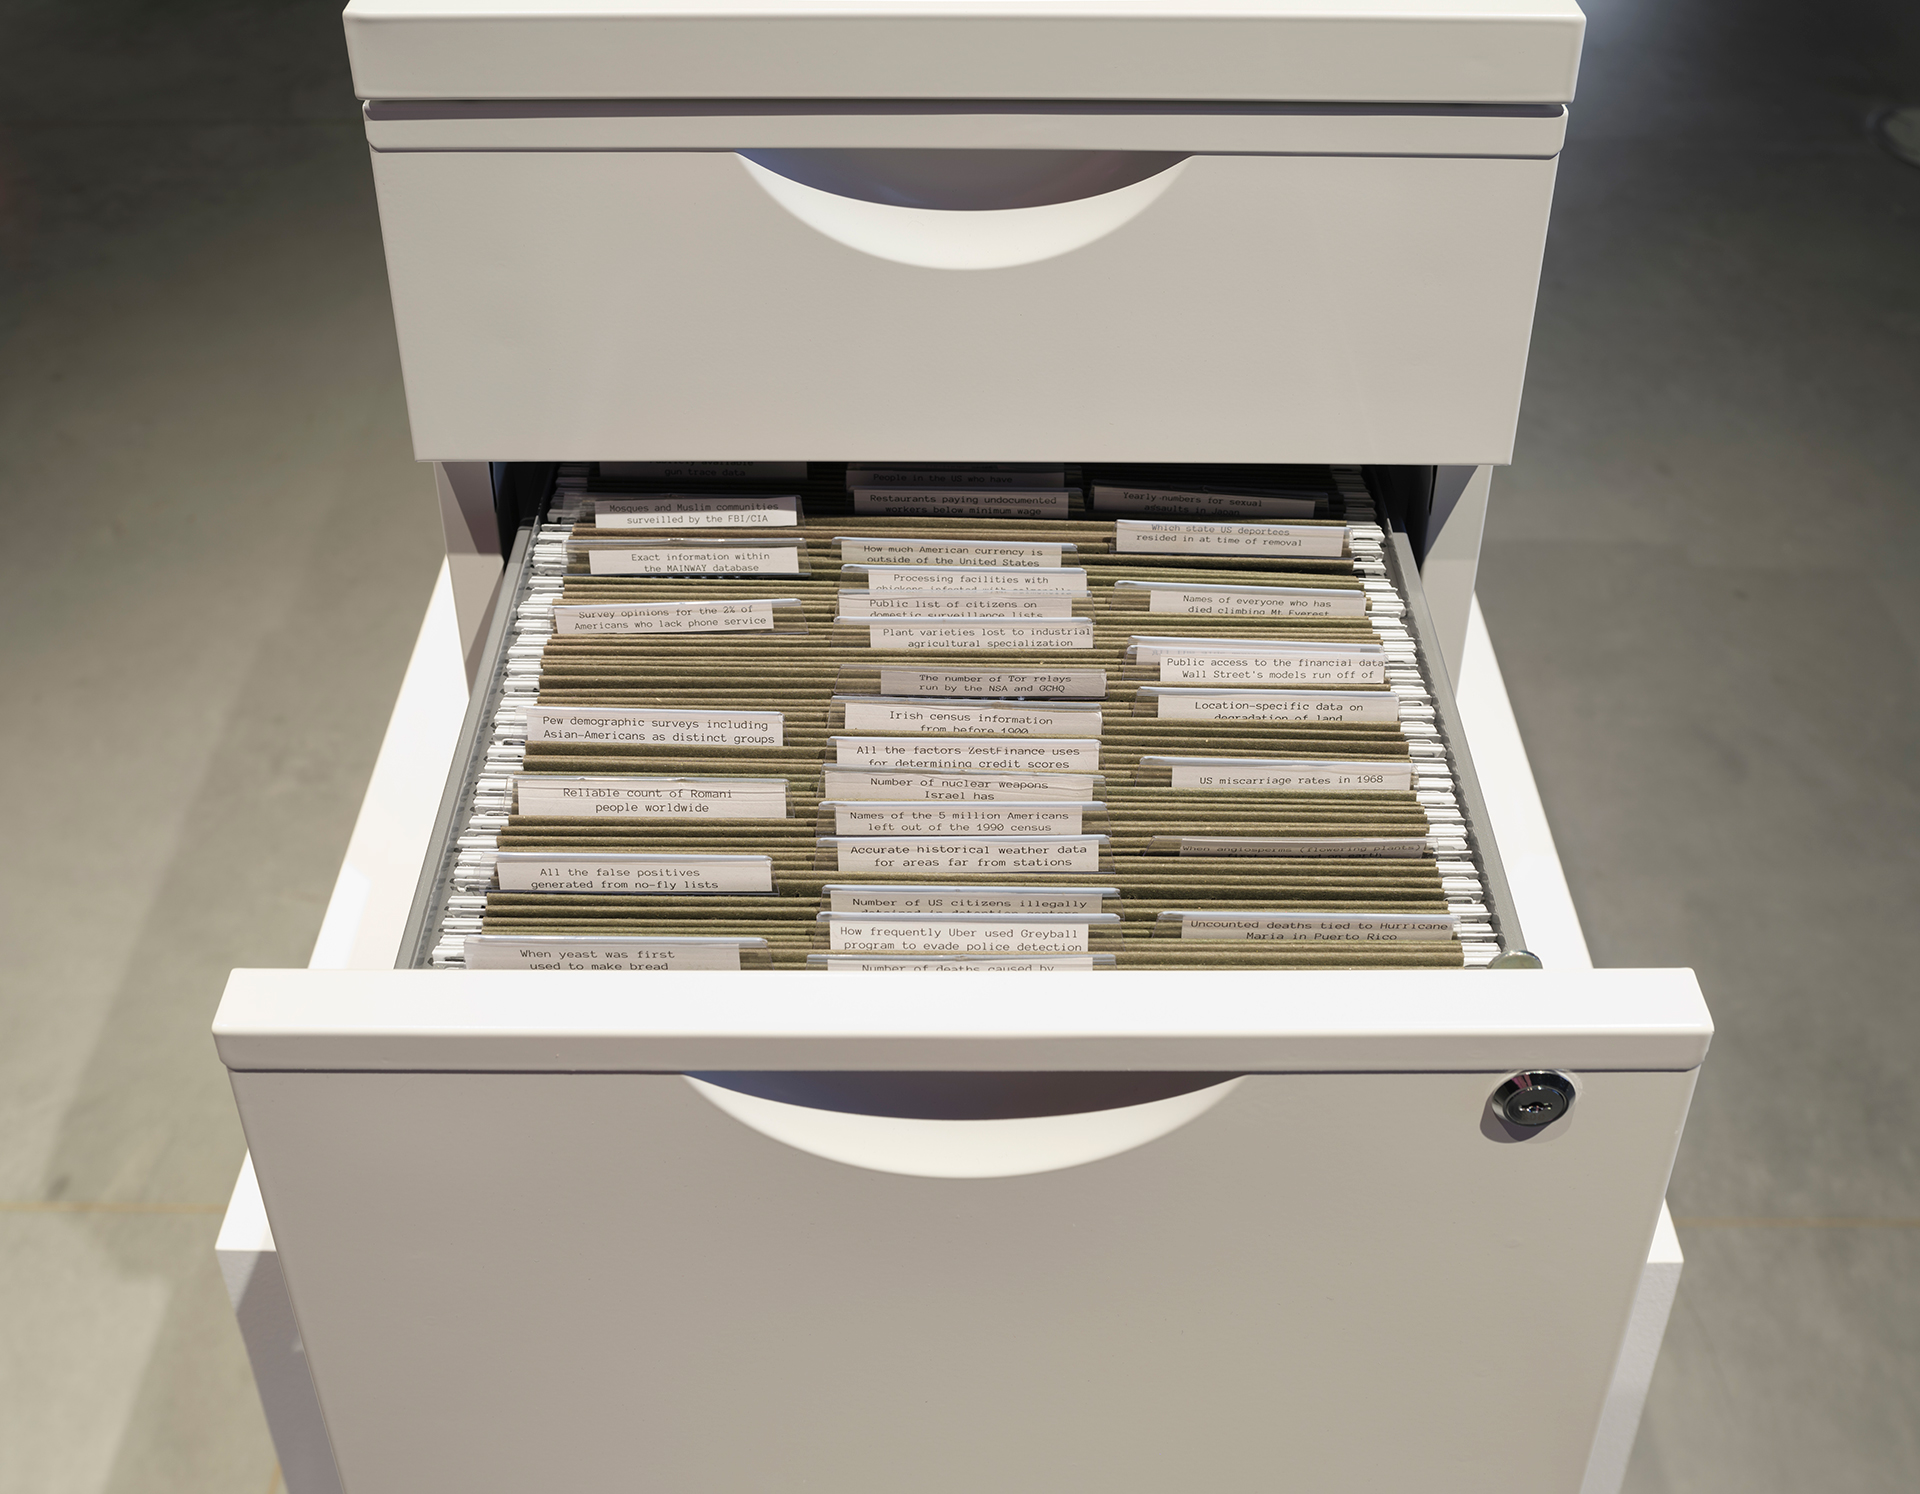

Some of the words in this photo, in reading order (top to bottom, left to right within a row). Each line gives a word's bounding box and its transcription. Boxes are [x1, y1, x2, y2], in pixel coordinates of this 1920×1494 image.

[869, 495, 936, 503] Restaurants
[941, 496, 978, 505] paying
[983, 496, 1056, 504] undocumented
[609, 504, 649, 514] Mosques
[654, 504, 671, 512] and
[676, 503, 711, 511] Muslim
[715, 503, 778, 511] communities
[933, 506, 964, 514] below
[1017, 508, 1042, 516] wage
[626, 515, 683, 524] surveilled
[688, 515, 700, 525] by
[705, 515, 722, 523] the
[727, 514, 768, 525] FBI/CIA
[631, 553, 660, 561] Exact
[666, 553, 729, 561] information
[734, 552, 769, 560] within
[644, 564, 661, 572] the
[666, 564, 706, 572] MAINWAY
[712, 564, 759, 572] database
[893, 574, 953, 585] Processing
[960, 575, 1019, 584] facilities
[1024, 576, 1048, 584] with
[1182, 595, 1212, 603] Names
[1218, 596, 1230, 604] of
[1236, 598, 1284, 608] everyone
[1289, 598, 1308, 607] who
[1313, 599, 1331, 607] has
[574, 621, 628, 630] Americans
[633, 620, 653, 628] who
[659, 619, 682, 628] lack
[687, 618, 718, 629] phone
[723, 617, 766, 626] service
[883, 628, 914, 636] Plant
[919, 628, 975, 636] varieties
[982, 628, 1005, 636] lost
[1012, 628, 1024, 636] to
[1031, 628, 1092, 636] industrial
[907, 639, 980, 649] agricultural
[987, 639, 1073, 648] specialization
[1166, 658, 1204, 666] Public
[1254, 659, 1267, 667] to
[1273, 658, 1291, 667] the
[1298, 658, 1351, 667] financial
[1358, 658, 1385, 667] data
[1181, 670, 1206, 678] Wall
[1213, 670, 1263, 679] Street's
[1268, 670, 1306, 679] models
[1336, 671, 1355, 679] off
[1361, 671, 1373, 679] of
[1194, 701, 1309, 713] Location-specific
[1315, 702, 1343, 711] data
[890, 711, 923, 721] Irish
[929, 714, 970, 722] census
[978, 714, 1052, 725] information
[542, 716, 563, 725] Pew
[569, 716, 644, 729] demographic
[651, 720, 699, 730] surveys
[707, 719, 768, 732] including
[543, 730, 645, 741] Asian-Americans
[672, 732, 727, 742] distinct
[733, 735, 774, 745] groups
[856, 746, 876, 755] All
[884, 746, 905, 755] the
[913, 746, 961, 755] factors
[870, 778, 913, 787] Number
[919, 779, 934, 787] of
[941, 779, 991, 788] nuclear
[997, 782, 1048, 791] weapons
[1199, 777, 1212, 785] US
[1219, 776, 1291, 786] miscarriage
[1298, 776, 1330, 784] rates
[1356, 775, 1383, 783] 1968
[562, 788, 620, 798] Reliable
[626, 789, 663, 798] count
[669, 789, 684, 798] of
[690, 789, 734, 799] Romani
[924, 791, 965, 800] Israel
[973, 792, 994, 800] has
[595, 802, 638, 814] people
[644, 803, 709, 812] worldwide
[850, 812, 884, 820] Names
[890, 812, 904, 820] of
[911, 812, 932, 820] the
[938, 812, 945, 820] 5
[952, 812, 1000, 820] million
[1006, 812, 1068, 820] Americans
[868, 822, 894, 831] left
[900, 823, 922, 831] out
[928, 823, 941, 831] of
[949, 823, 969, 831] the
[976, 823, 1004, 831] 1990
[850, 846, 909, 854] Accurate
[916, 846, 989, 854] historical
[998, 846, 1049, 854] weather
[1057, 846, 1086, 854] data
[874, 858, 894, 866] for
[948, 858, 968, 866] far
[978, 858, 1006, 866] from
[1013, 858, 1072, 866] stations
[539, 868, 559, 876] All
[568, 868, 588, 876] the
[596, 868, 630, 877] false
[637, 868, 700, 879] positives
[530, 880, 593, 890] generated
[601, 880, 628, 888] from
[634, 880, 676, 890] no-fly
[684, 880, 718, 888] lists
[904, 899, 919, 907] of
[928, 899, 942, 907] US
[1020, 900, 1087, 909] illegally
[1190, 920, 1259, 928] Uncounted
[1266, 921, 1312, 929] deaths
[1320, 921, 1350, 929] tied
[1379, 922, 1448, 930] Hurricane
[840, 927, 862, 936] How
[870, 927, 941, 939] frequently
[948, 928, 976, 937] Uber
[984, 929, 1013, 938] used
[1020, 929, 1076, 941] Greyball
[1245, 932, 1284, 940] Maria
[1292, 932, 1307, 940] in
[1313, 932, 1359, 940] Puerto
[844, 943, 894, 951] program
[902, 942, 916, 950] to
[922, 942, 959, 951] evade
[966, 942, 1010, 951] police
[1016, 943, 1081, 952] detection
[519, 949, 551, 958] When
[558, 950, 597, 960] yeast
[637, 950, 675, 958] first
[529, 962, 560, 970] used
[568, 962, 584, 970] to
[590, 962, 622, 970] make
[629, 962, 668, 970] bread
